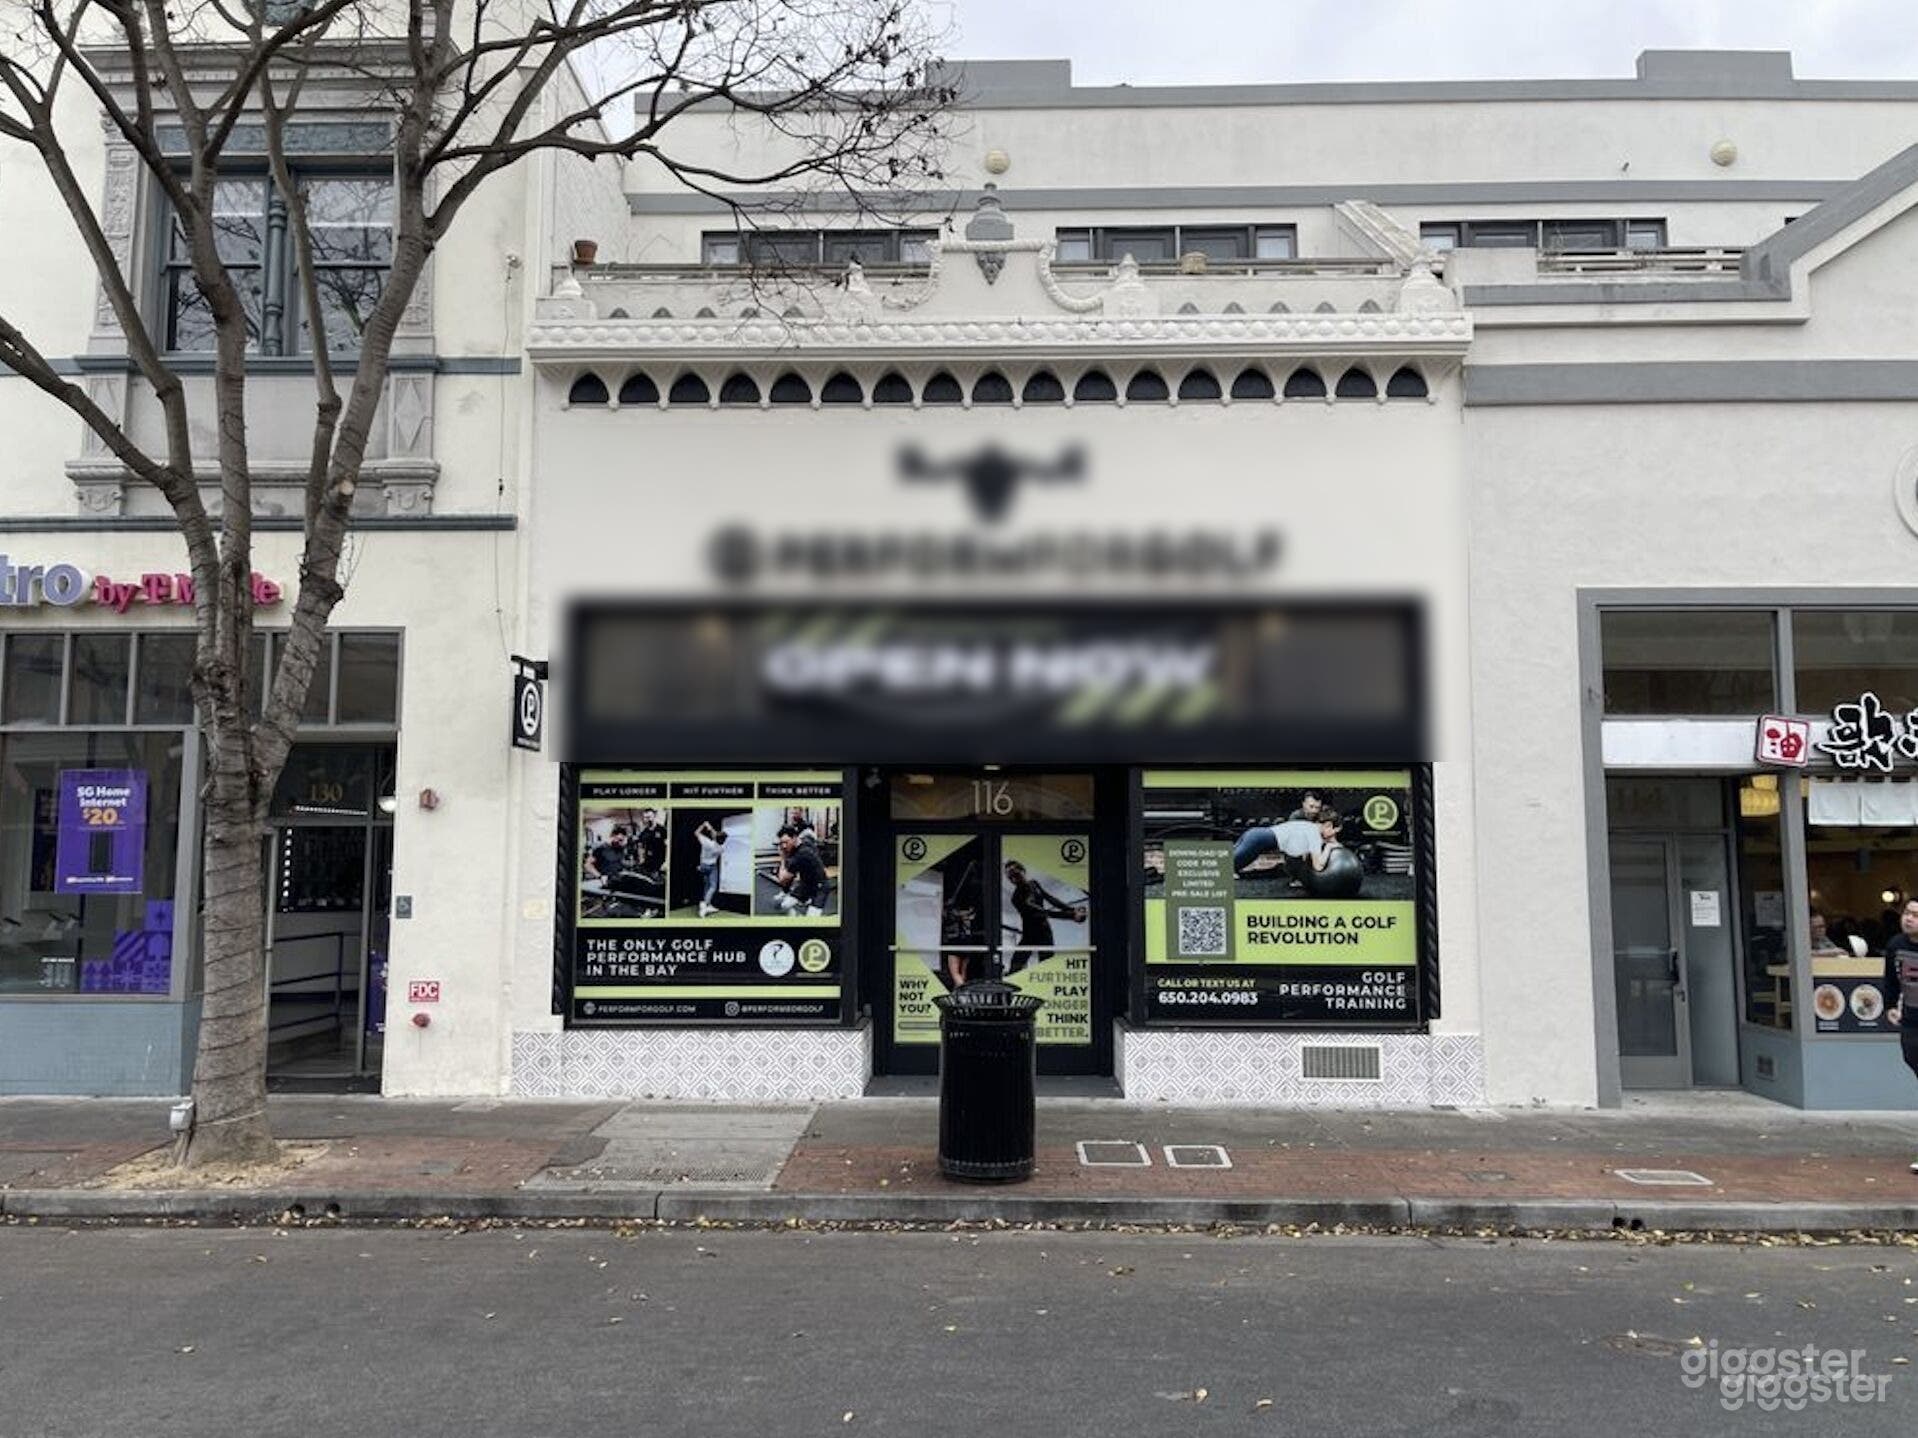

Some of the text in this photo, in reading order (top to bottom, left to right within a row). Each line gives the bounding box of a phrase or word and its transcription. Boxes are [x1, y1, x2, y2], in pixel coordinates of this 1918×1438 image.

[96, 575, 137, 613] by
[1766, 720, 1803, 758] 油
[96, 786, 131, 797] Home
[593, 787, 657, 795] PLAY LONGER
[702, 787, 744, 795] FURTHER
[765, 787, 832, 795] THINK BETTER
[80, 798, 127, 808] Internet
[972, 780, 1013, 815] 116
[83, 807, 118, 825] $20
[1247, 916, 1396, 929] BUILDING A GOLF
[1248, 932, 1359, 944] REVOLUTION
[587, 939, 713, 950] THE ONLY GOLF
[587, 951, 746, 963] PERFORMANCE HUB
[1066, 958, 1087, 969] HIT
[587, 965, 678, 976] IN THE BAY
[1029, 973, 1087, 983] FURTHER
[1157, 978, 1256, 988] CALL OR TEXT US AT
[1362, 972, 1405, 983] GOLF
[411, 983, 438, 997] FDC
[900, 980, 928, 989] WHY
[1054, 986, 1088, 996] PLAY
[1279, 984, 1406, 997] PERFORMANCE
[900, 992, 924, 1001] NOT
[1159, 991, 1259, 1005] 650.204.0983
[900, 1004, 931, 1013] YOU?
[1041, 1000, 1087, 1010] ONGER
[1326, 998, 1407, 1010] TRAINING
[1047, 1013, 1088, 1024] THINK
[1036, 1027, 1089, 1038] BETTER.
